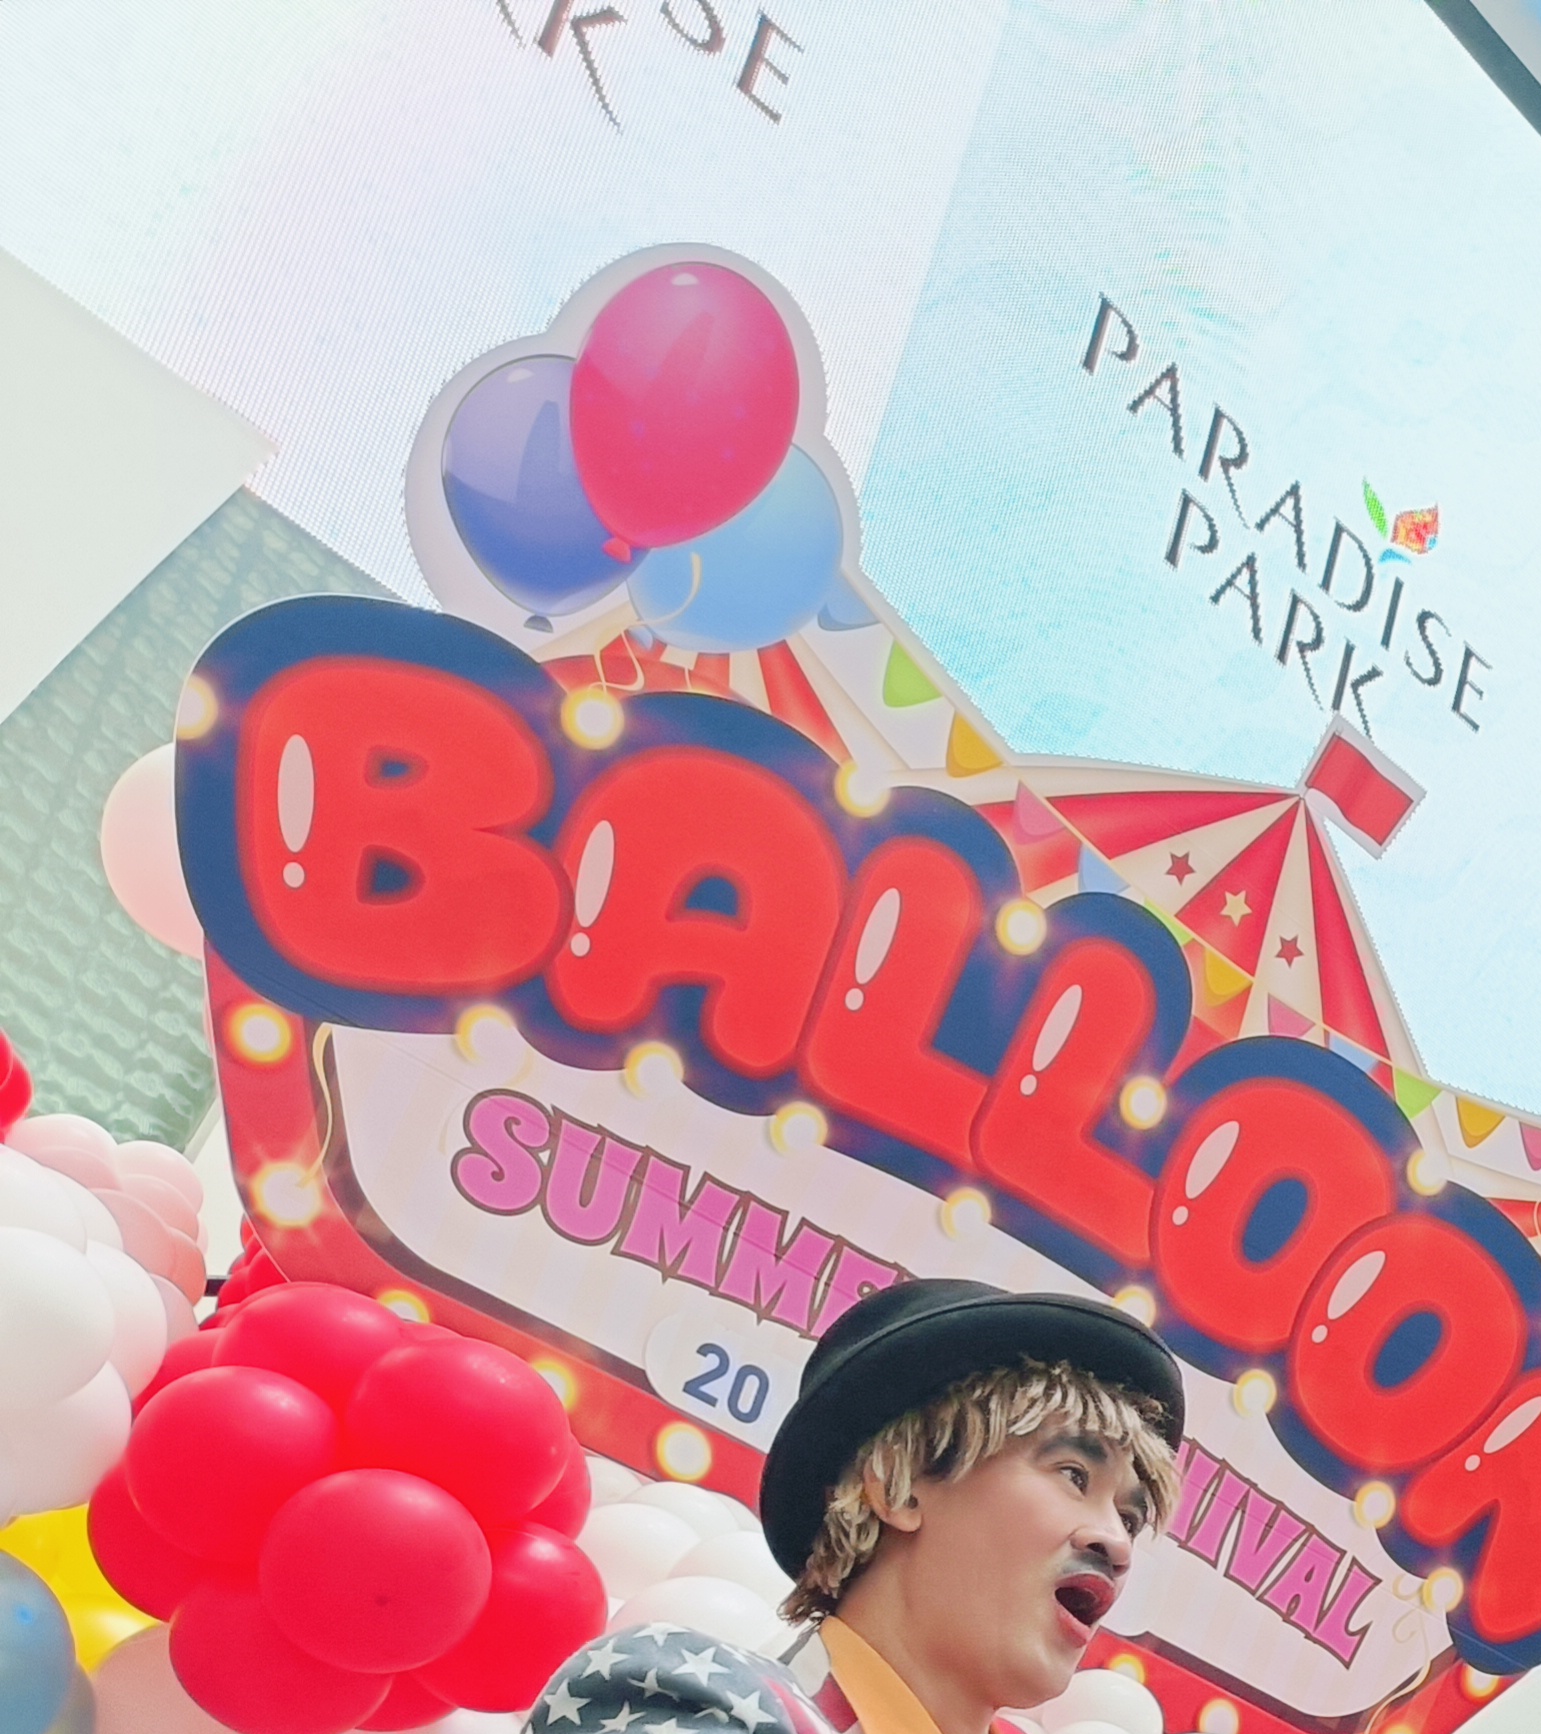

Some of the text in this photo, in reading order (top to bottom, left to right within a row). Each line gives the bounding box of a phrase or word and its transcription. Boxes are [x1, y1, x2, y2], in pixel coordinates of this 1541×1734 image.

[1081, 293, 1494, 733] PARADISE
[1165, 488, 1385, 738] PARK
[451, 1088, 914, 1342] SUMME
